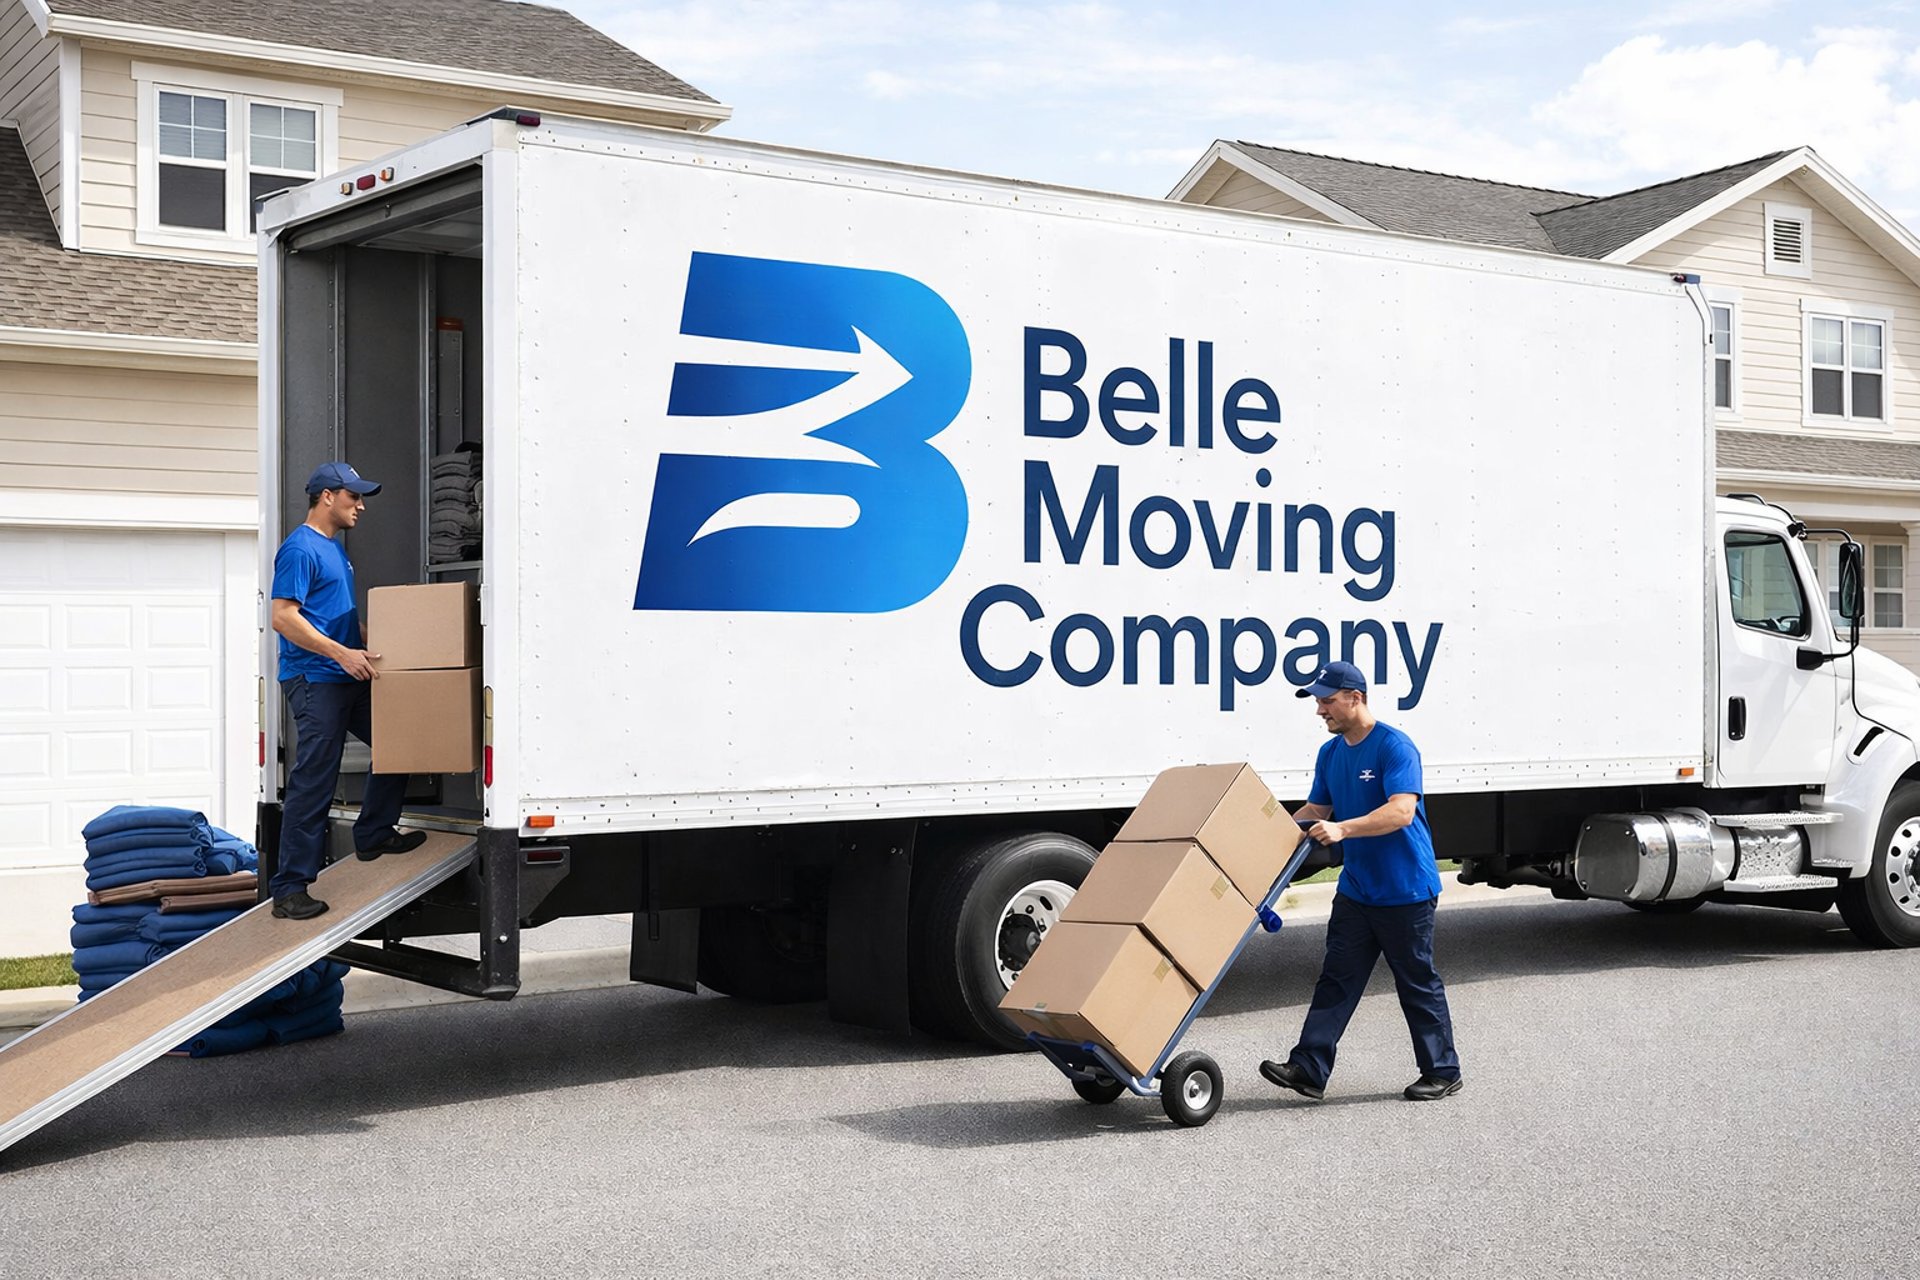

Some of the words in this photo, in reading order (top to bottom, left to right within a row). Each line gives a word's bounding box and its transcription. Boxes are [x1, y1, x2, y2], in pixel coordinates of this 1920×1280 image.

[1023, 325, 1281, 455] Belle
[1023, 459, 1396, 602] Moving
[959, 583, 1444, 711] Company
